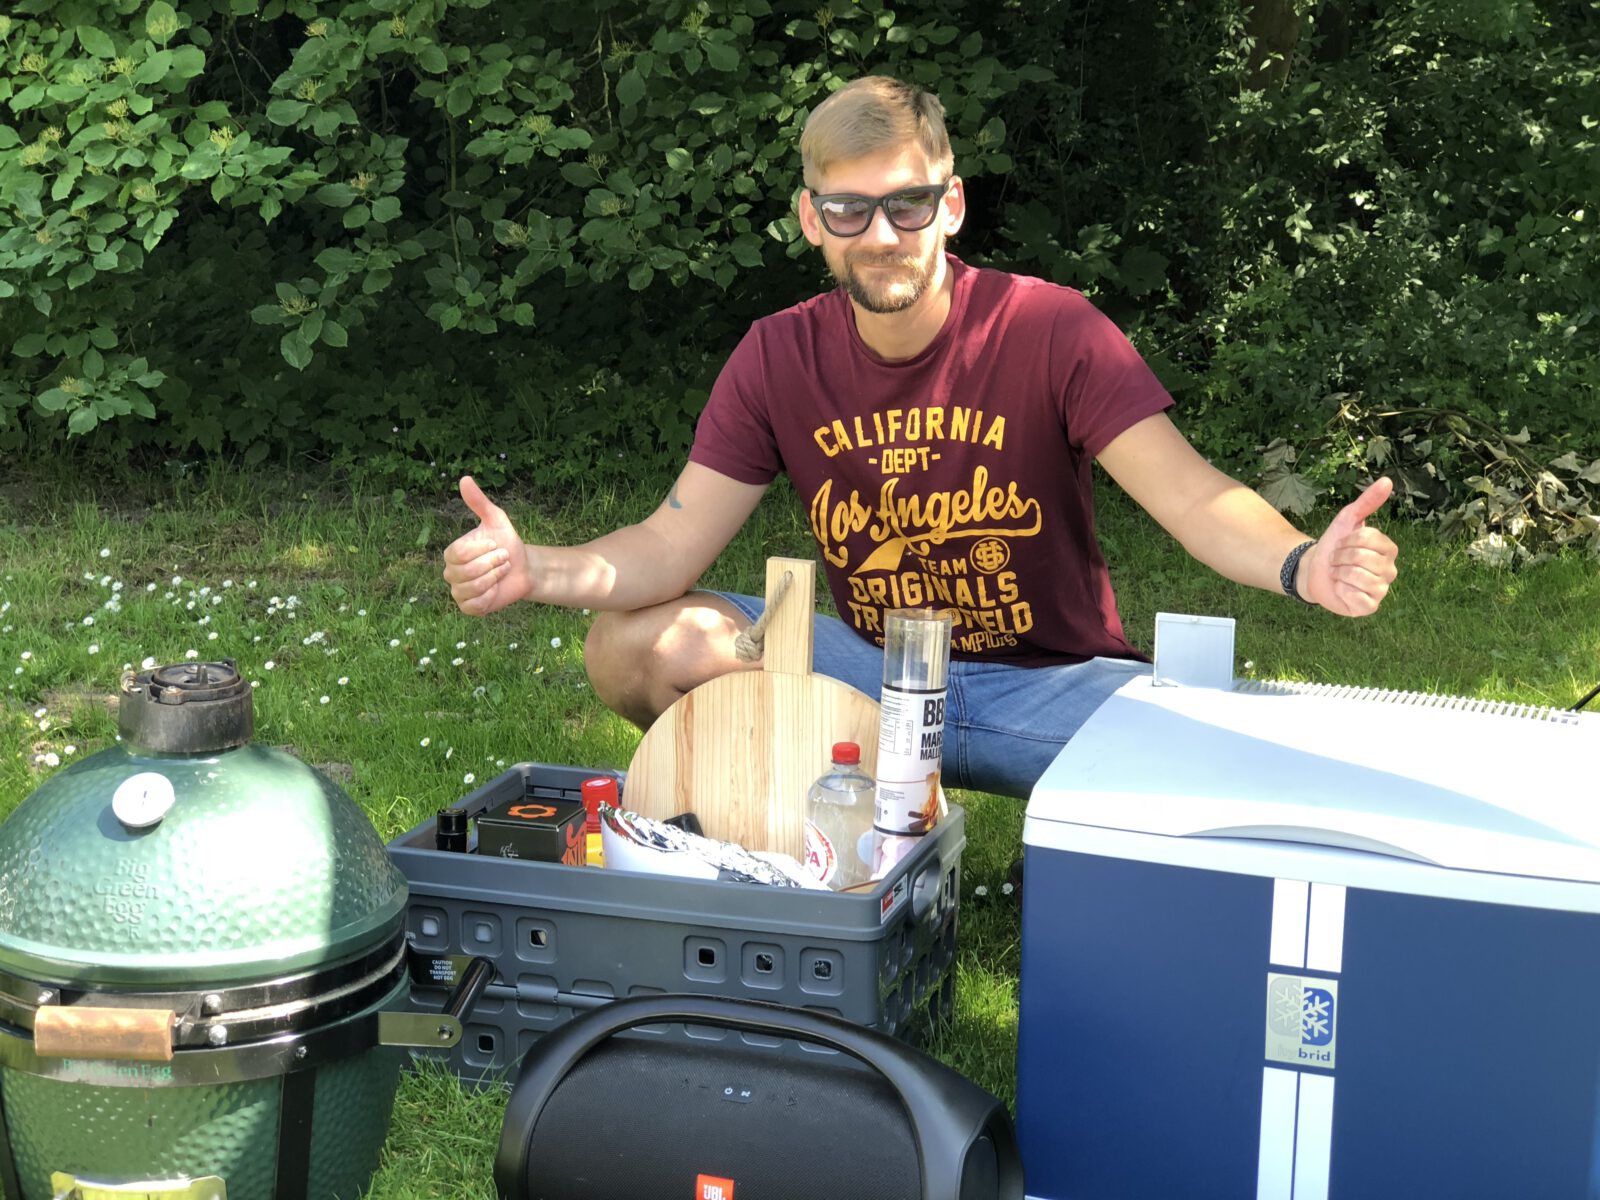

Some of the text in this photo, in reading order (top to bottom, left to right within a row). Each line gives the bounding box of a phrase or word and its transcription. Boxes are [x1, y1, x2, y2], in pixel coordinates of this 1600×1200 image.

[813, 406, 1006, 457] CALIFORNIA
[810, 478, 872, 568] Los
[868, 465, 1042, 557] Angeles
[918, 556, 968, 576] TEAM
[847, 570, 1020, 609] ORIGINALS
[92, 876, 159, 900] Green
[102, 895, 147, 925] Egg
[140, 1063, 174, 1082] Egg
[703, 1184, 727, 1200] JBL
